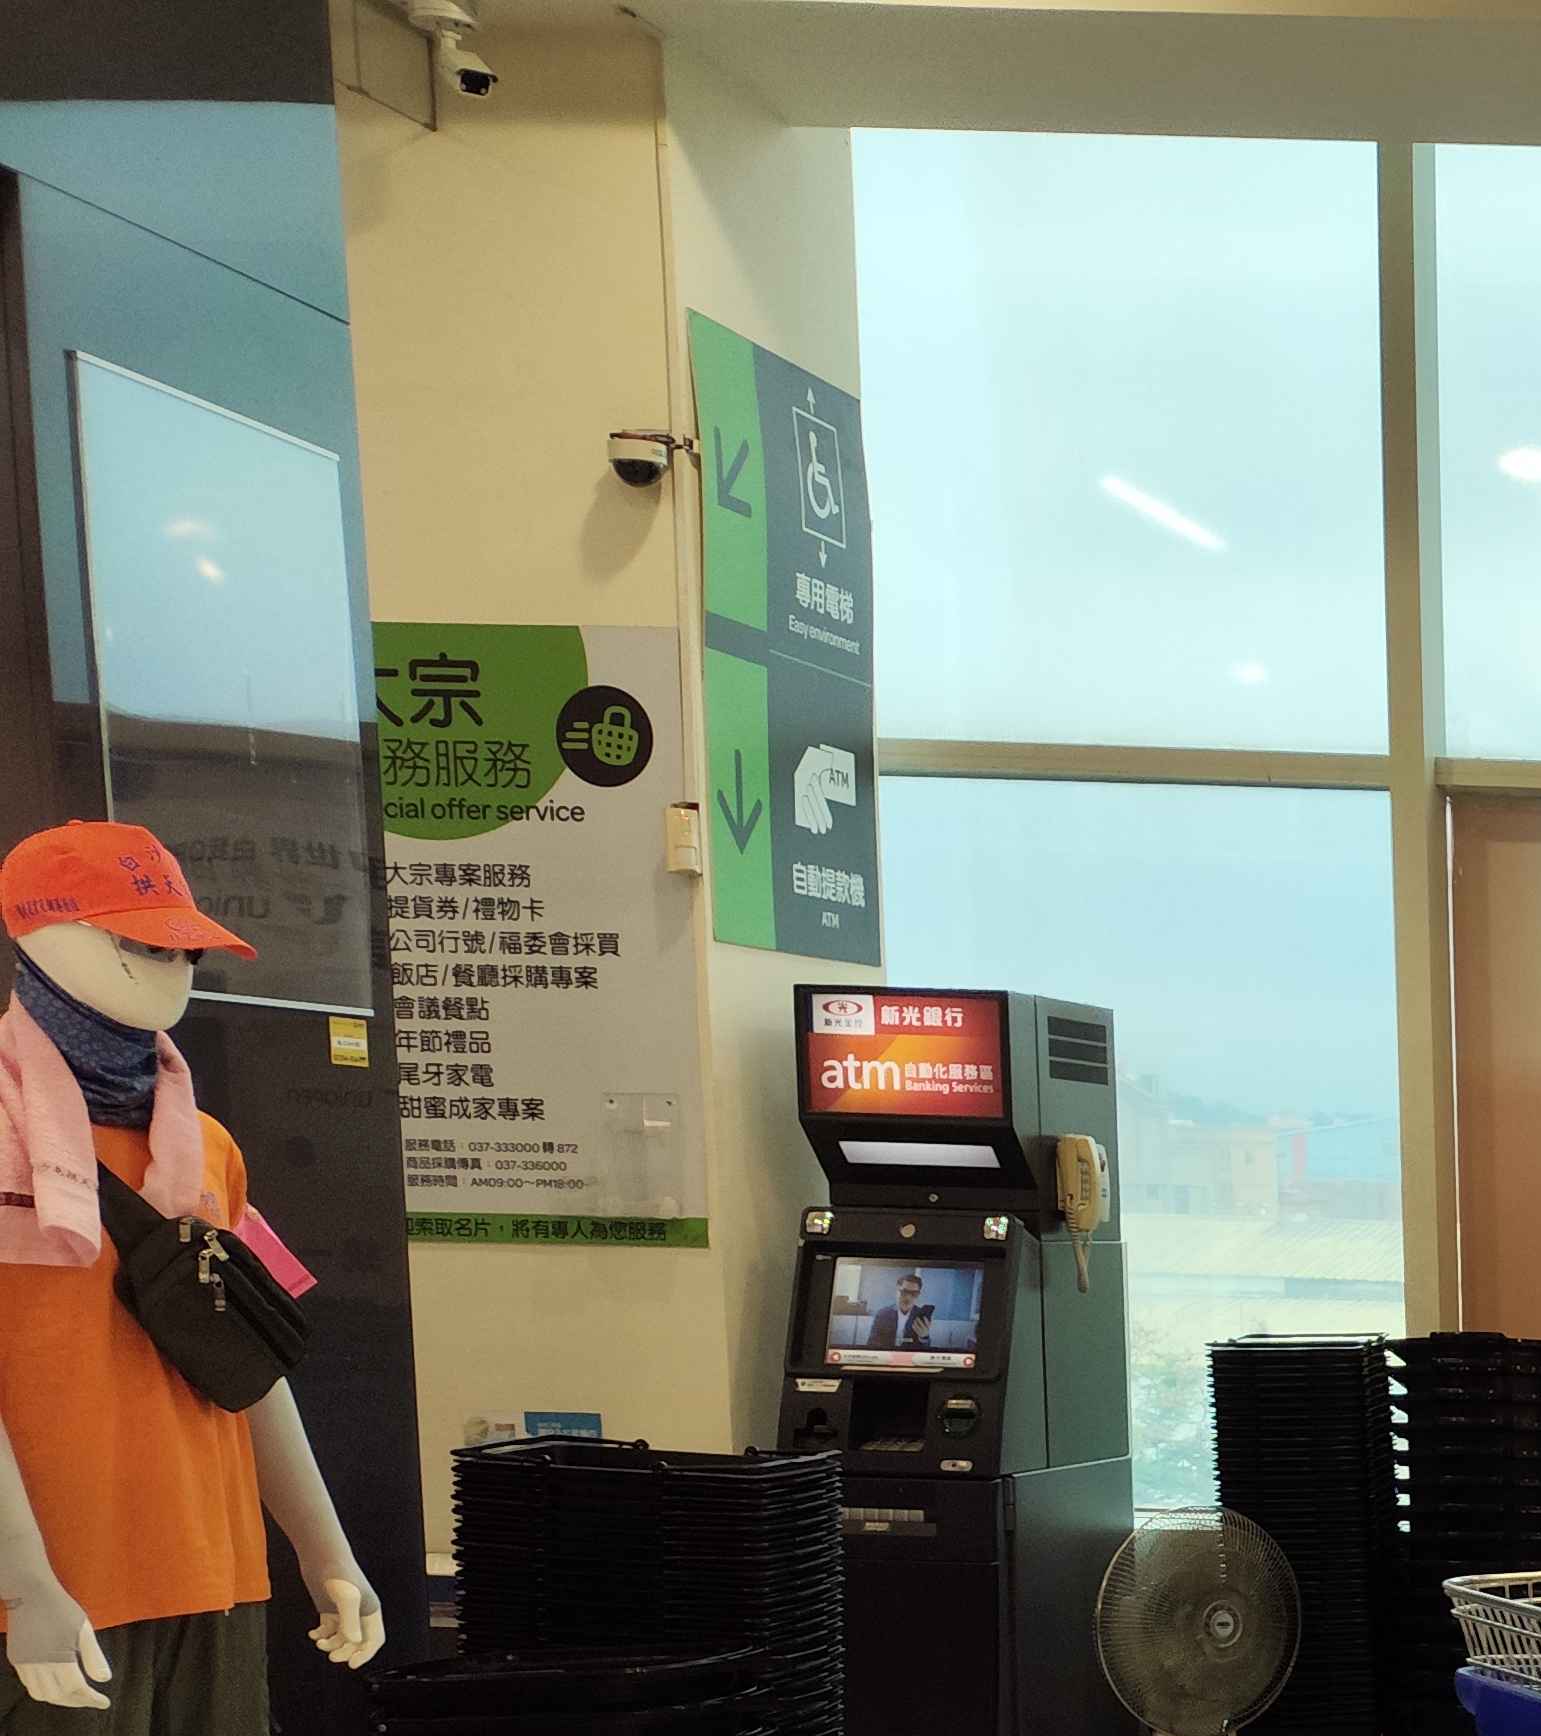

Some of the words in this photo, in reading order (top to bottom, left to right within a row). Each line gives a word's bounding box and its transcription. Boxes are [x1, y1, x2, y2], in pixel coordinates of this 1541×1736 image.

[795, 571, 855, 625] 專用電梯
[788, 613, 809, 640] Easy
[809, 625, 861, 656] environment
[828, 767, 850, 789] ATM
[431, 798, 490, 821] offer
[496, 801, 586, 824] service
[384, 861, 532, 889] 大宗專案服務
[791, 861, 867, 908] 自動提款機
[387, 895, 546, 923] 提貨券/禮物卡
[821, 910, 840, 930] ATM
[391, 961, 599, 990] 飯店/餐廳採購專案
[394, 995, 490, 1022] 會議餐點
[880, 1004, 965, 1029] 新光銀行
[395, 1029, 492, 1055] 年節禮品
[397, 1062, 495, 1088] 尾牙家電
[820, 1053, 901, 1091] atm
[904, 1080, 950, 1095] Banking
[951, 1081, 994, 1095] Services
[399, 1095, 546, 1122] 甜蜜成家專案
